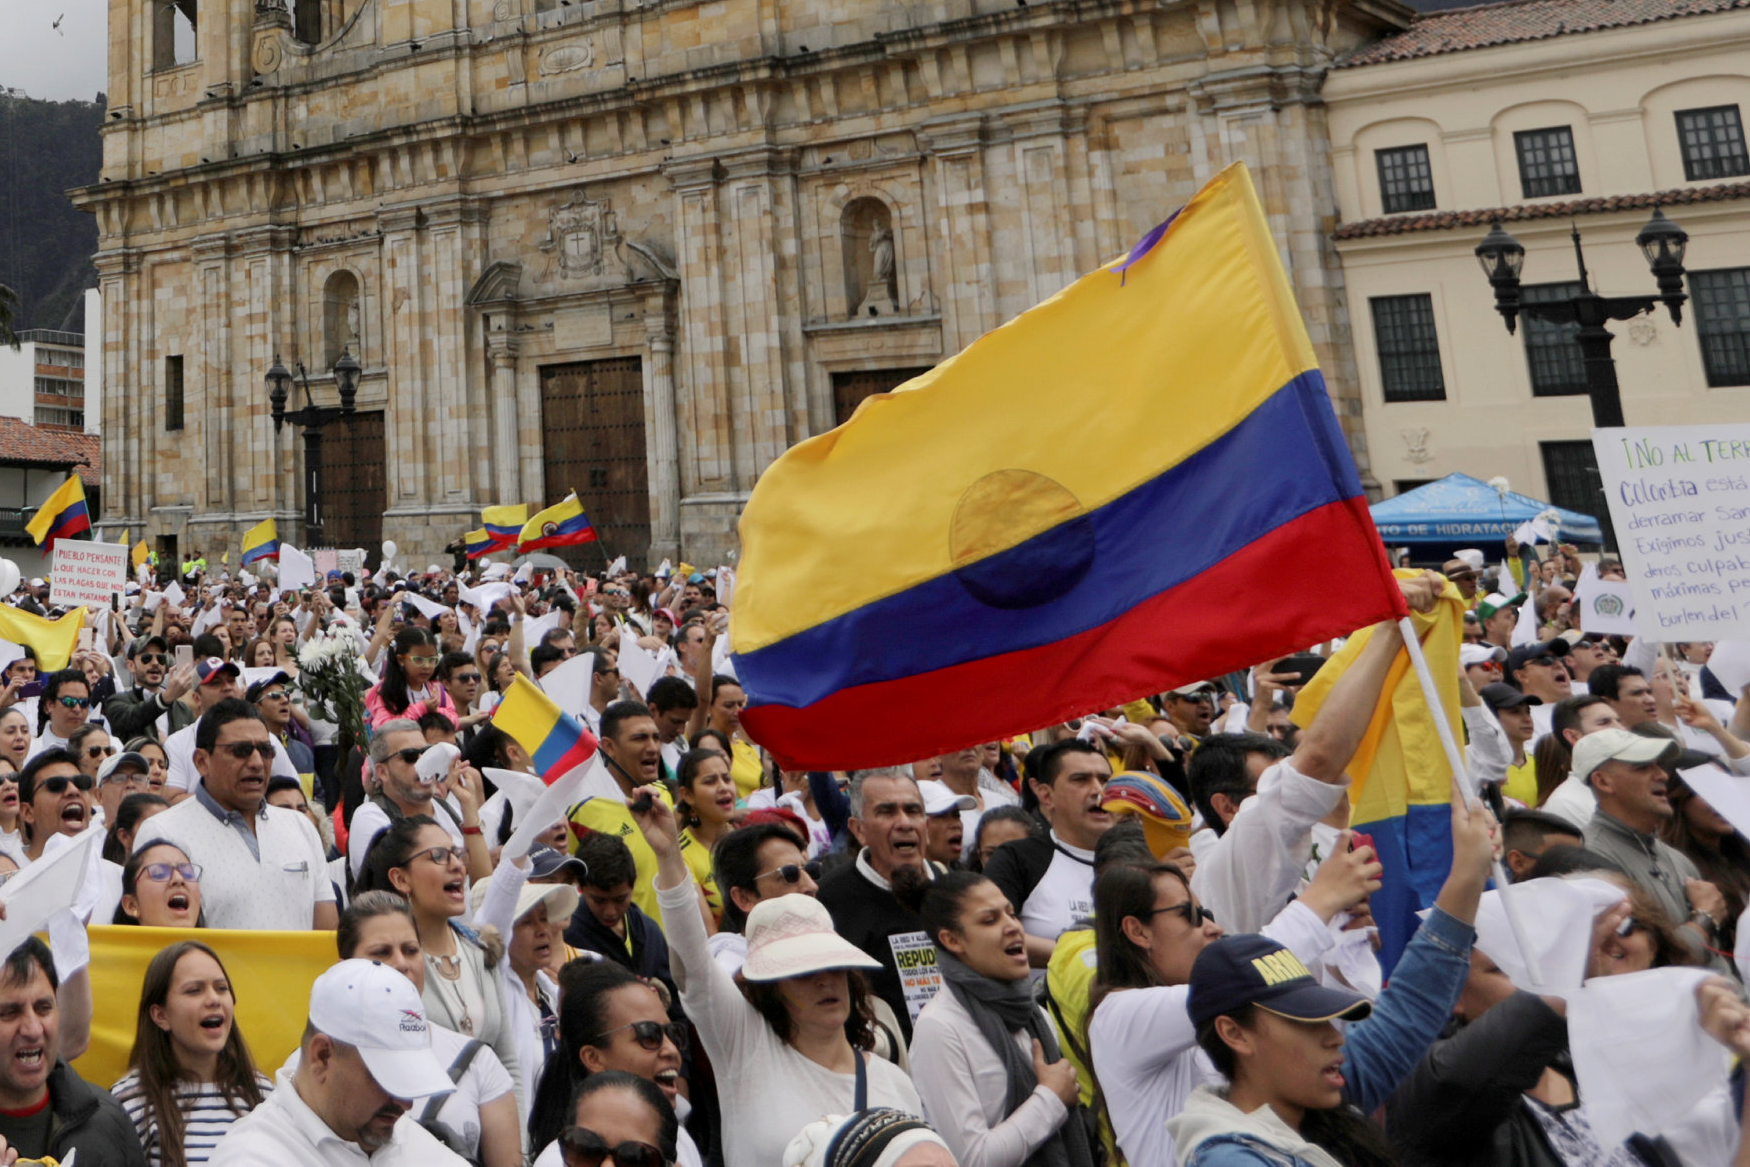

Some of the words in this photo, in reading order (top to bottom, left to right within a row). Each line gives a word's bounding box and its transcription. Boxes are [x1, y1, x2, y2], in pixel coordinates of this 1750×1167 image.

[1673, 442, 1697, 464] AL
[1620, 477, 1699, 507] Colombia
[1705, 475, 1748, 492] está
[1407, 524, 1428, 535] DE
[1628, 511, 1706, 531] derramar
[1634, 534, 1706, 555] Exigimos
[77, 565, 101, 576] HACER
[102, 569, 117, 578] CON
[53, 588, 76, 598] ESTAN
[54, 576, 67, 585] LAS
[68, 577, 95, 589] PLAGAS
[96, 581, 109, 590] QUE
[110, 583, 124, 592] NOS
[1650, 582, 1722, 601] máximas
